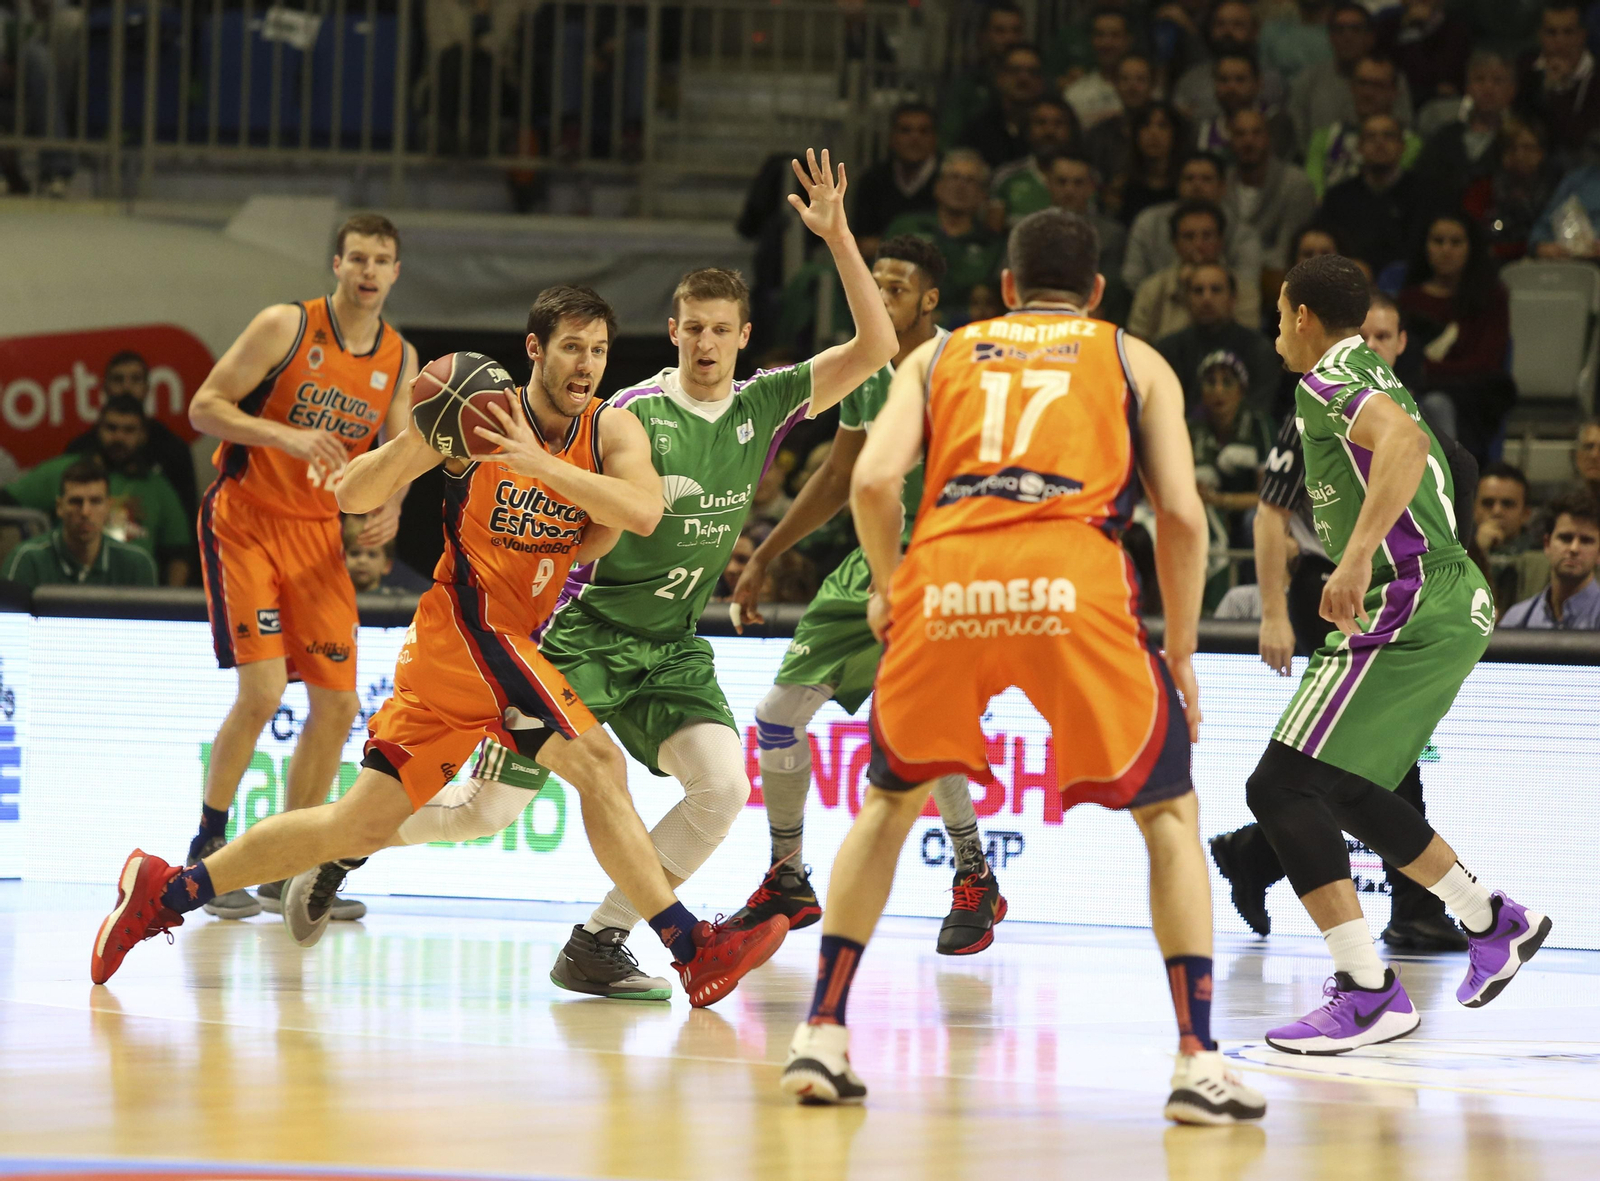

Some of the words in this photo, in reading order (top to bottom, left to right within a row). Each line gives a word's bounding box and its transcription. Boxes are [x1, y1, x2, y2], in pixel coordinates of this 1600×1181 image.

[988, 320, 1098, 343] MARTINEZ
[1, 361, 185, 432] ortn
[295, 380, 370, 420] Cultura
[978, 368, 1072, 463] 17
[649, 417, 678, 429] SPALDING
[495, 479, 580, 523] Cultura
[531, 558, 555, 598] 9
[653, 566, 705, 600] 21
[923, 577, 1077, 618] PAMESA
[510, 762, 541, 776] SPALDING
